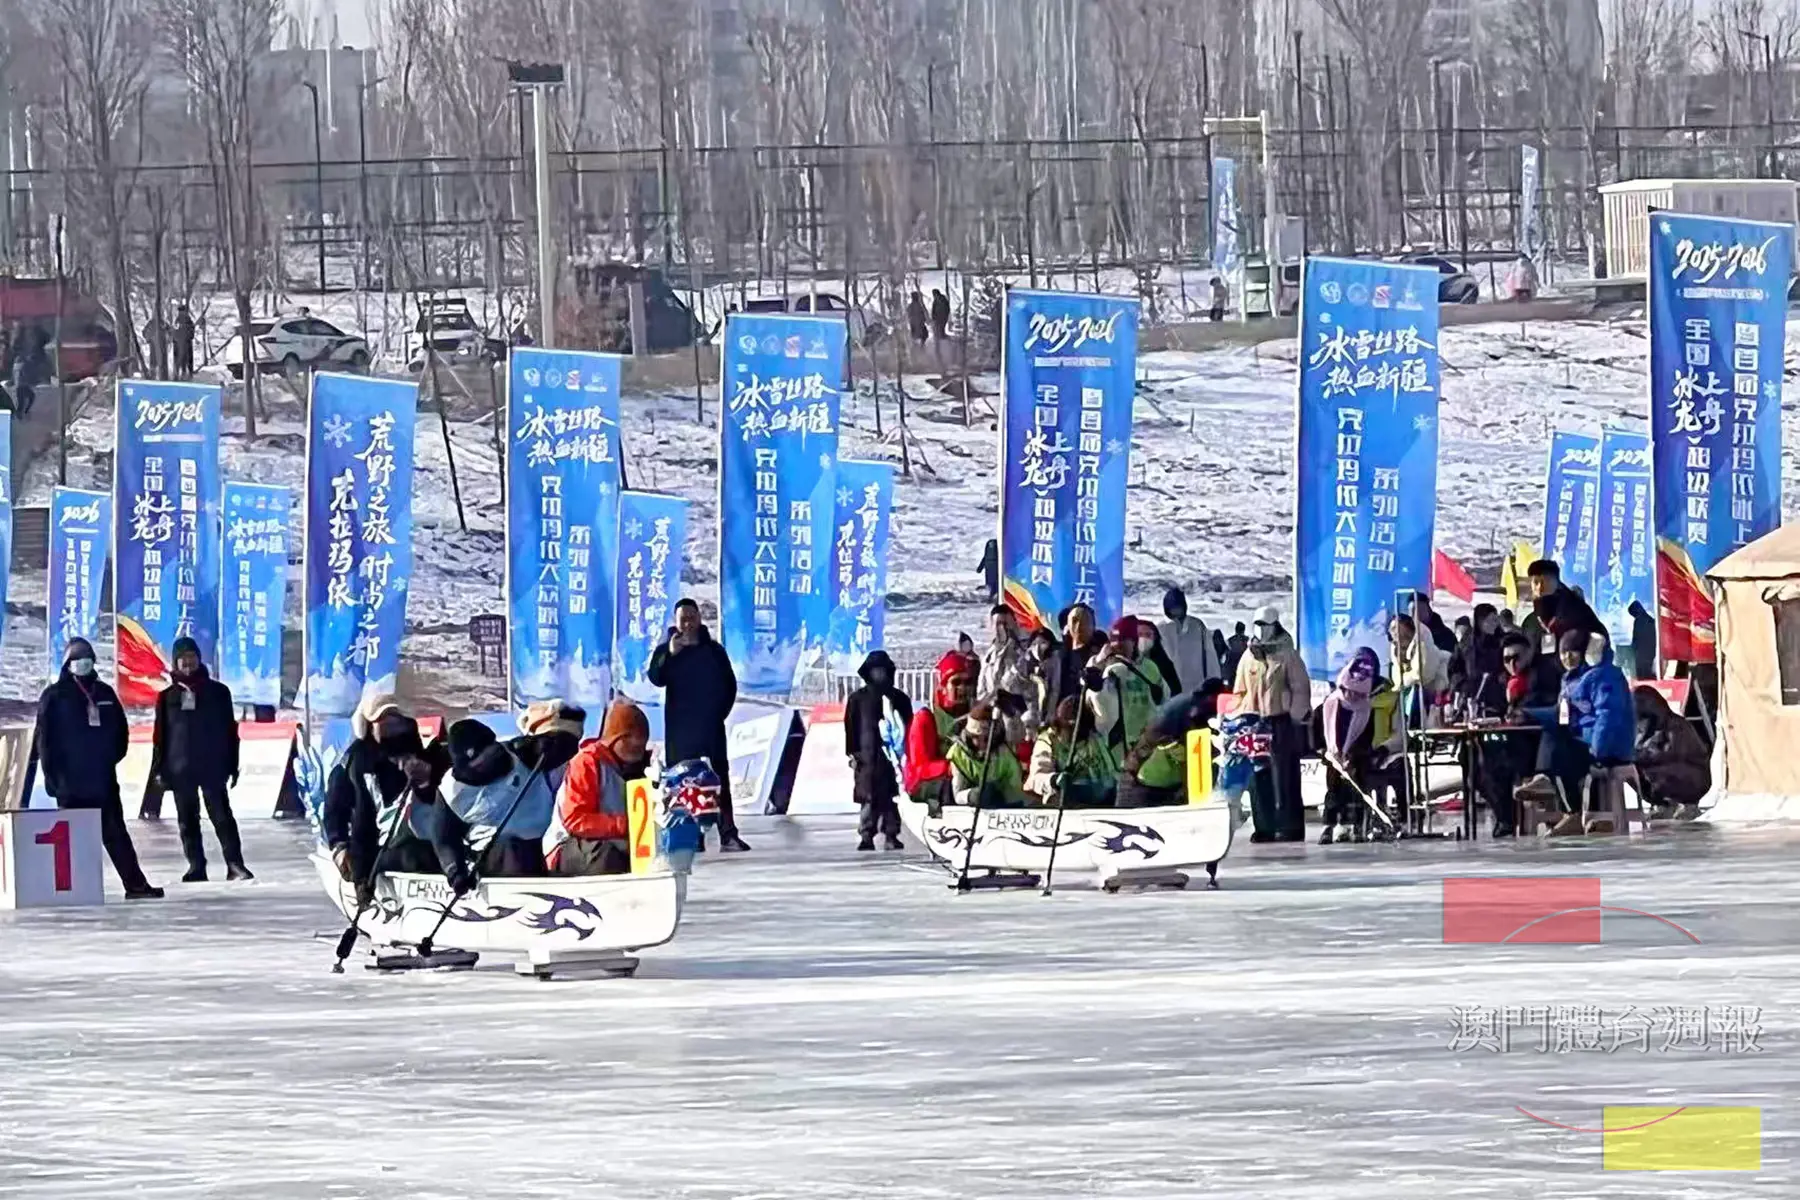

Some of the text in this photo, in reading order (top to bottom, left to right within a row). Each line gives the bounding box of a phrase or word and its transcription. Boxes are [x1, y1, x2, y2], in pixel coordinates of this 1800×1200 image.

[1672, 235, 1778, 284] 2025-2026
[1024, 310, 1124, 353] 2025-2026
[1308, 324, 1436, 371] 冰雪丝路
[728, 372, 837, 413] 冰雪丝路
[1322, 359, 1435, 412] 热血新疆
[740, 402, 835, 449] 热血新疆
[327, 467, 362, 610] 克拉玛依
[344, 409, 397, 677] 荒野之旅 时尚之都
[1193, 735, 1204, 795] 1
[632, 785, 651, 858] 2
[35, 820, 72, 891] 1
